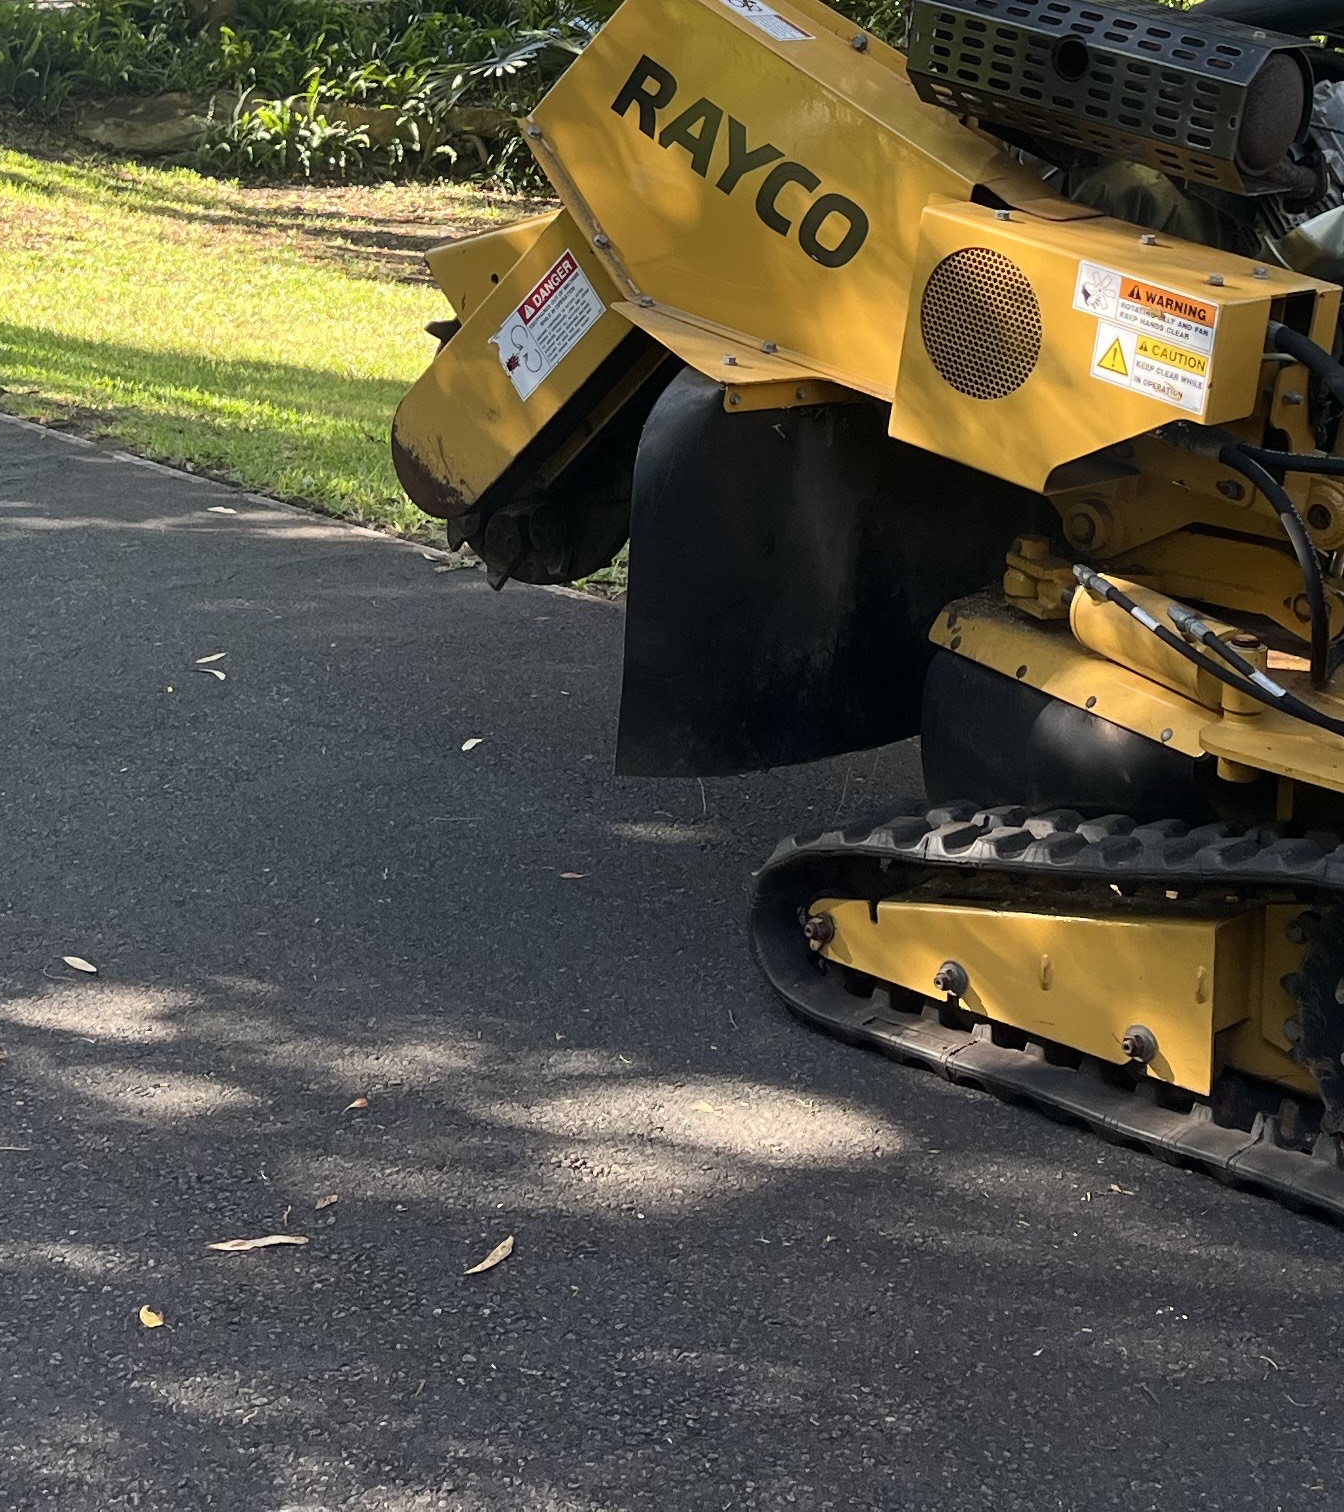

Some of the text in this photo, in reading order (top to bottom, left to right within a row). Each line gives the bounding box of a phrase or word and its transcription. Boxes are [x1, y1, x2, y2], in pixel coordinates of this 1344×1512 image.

[611, 54, 869, 268] RAYCO
[532, 259, 574, 307] DANGER
[1145, 290, 1207, 321] WARNING
[1119, 311, 1190, 340] KEEP HANDS CLEAR
[1177, 321, 1192, 331] AND
[1194, 326, 1209, 337] FAN
[1152, 345, 1206, 372] CAUTION
[1133, 376, 1141, 385] IN
[1136, 361, 1203, 389] KEEP CLEAR WHILE
